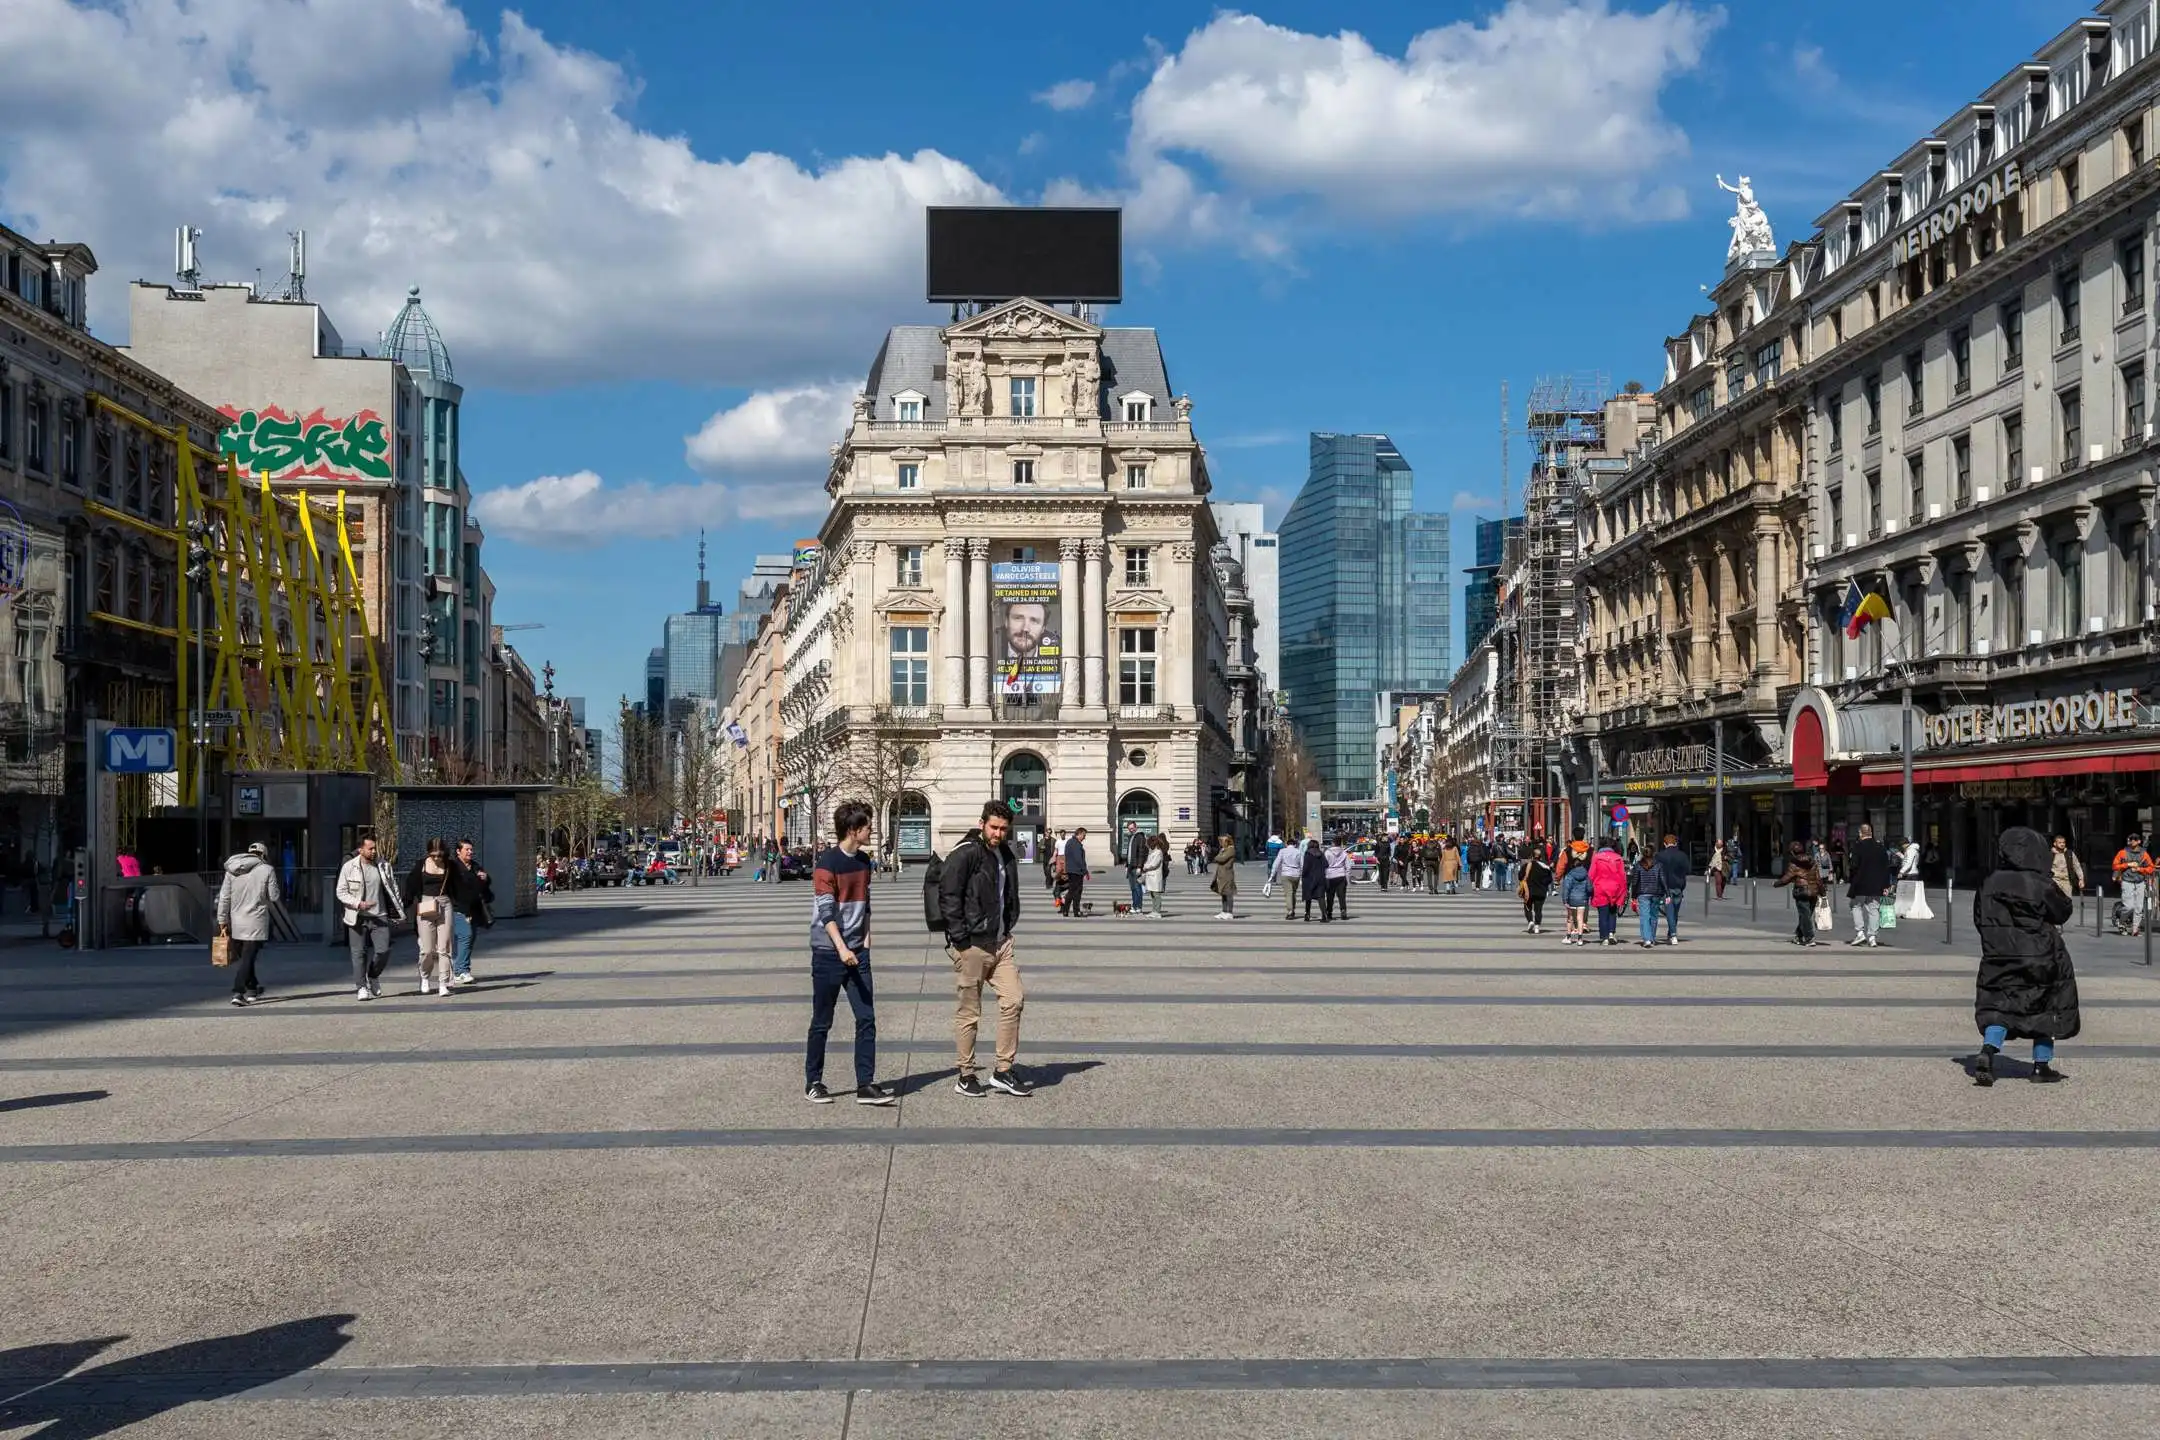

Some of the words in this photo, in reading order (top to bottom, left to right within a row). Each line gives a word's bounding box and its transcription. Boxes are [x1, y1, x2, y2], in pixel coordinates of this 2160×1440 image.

[1892, 160, 2021, 268] METROPOLE
[996, 572, 1056, 580] VANDECASTEELE
[1922, 708, 1983, 748] HOTEL
[1992, 688, 2136, 739] METROPOLE
[111, 734, 170, 766] M
